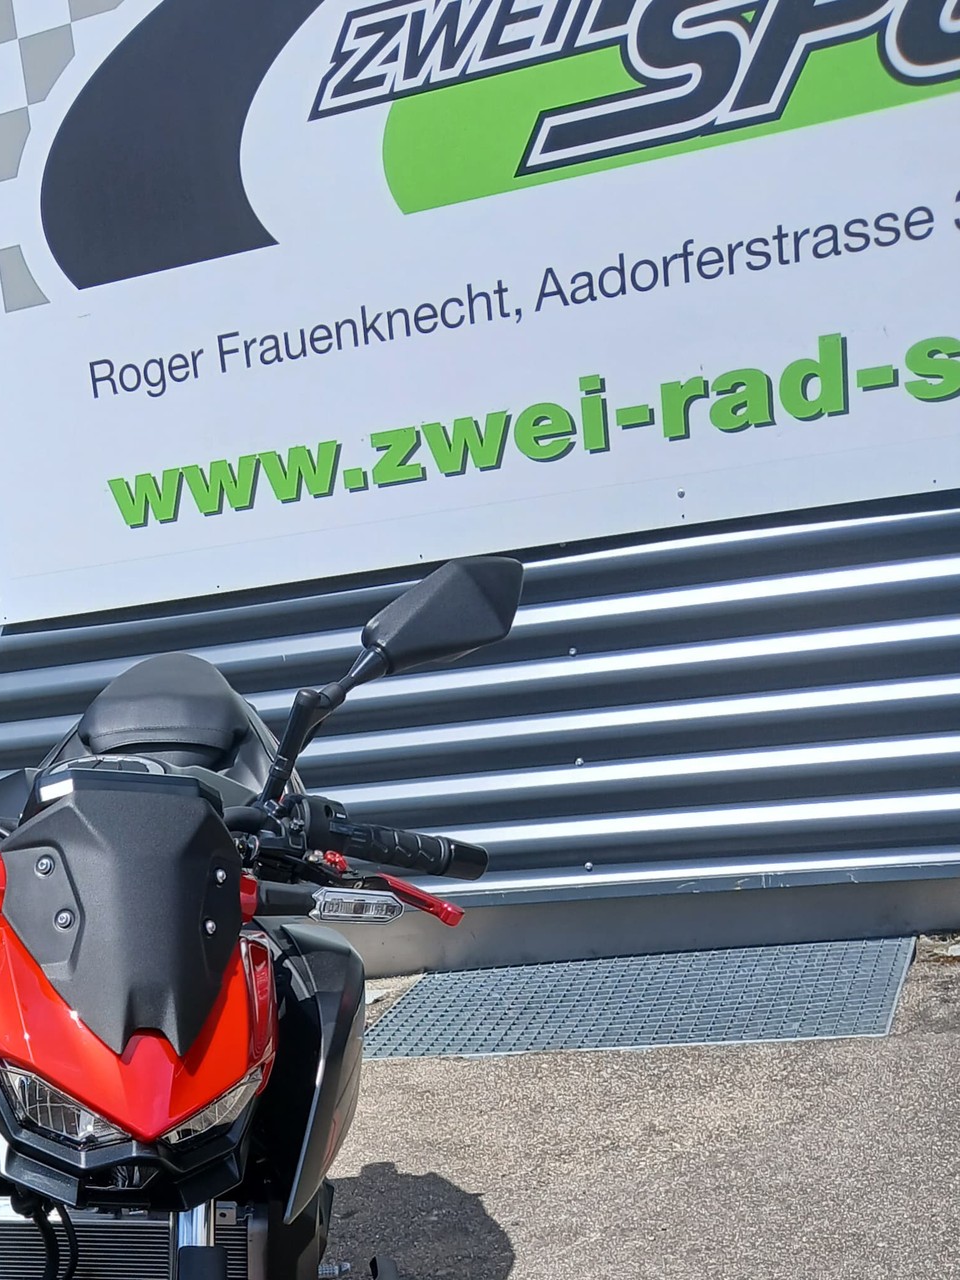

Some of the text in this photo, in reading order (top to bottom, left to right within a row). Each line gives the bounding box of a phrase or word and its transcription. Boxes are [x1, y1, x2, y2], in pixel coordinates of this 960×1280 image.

[537, 0, 960, 157] SP
[88, 346, 205, 400] Roger
[217, 279, 523, 374] Frauenknecht,
[535, 205, 935, 313] Aadorferstrasse
